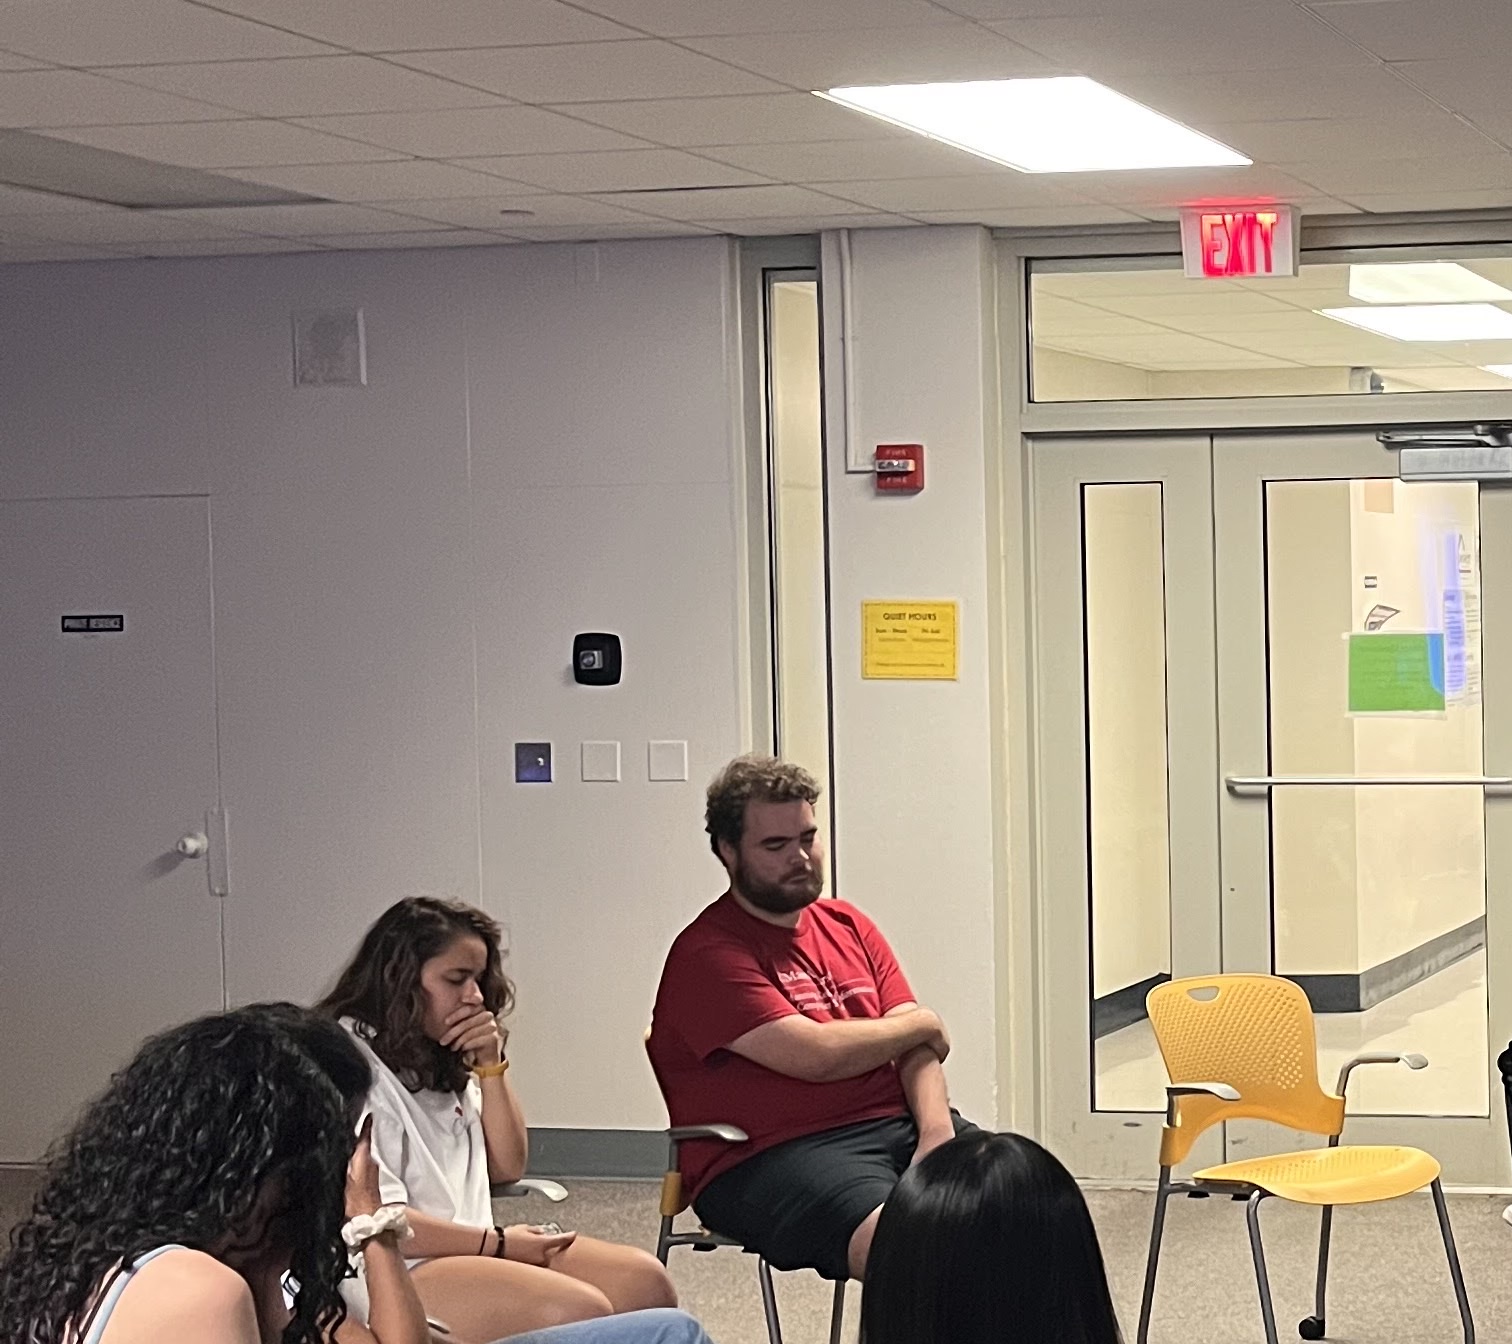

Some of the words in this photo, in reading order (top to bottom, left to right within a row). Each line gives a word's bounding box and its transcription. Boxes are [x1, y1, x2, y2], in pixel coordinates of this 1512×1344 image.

[1201, 211, 1278, 277] EXIT
[882, 612, 907, 621] QUIET
[908, 612, 938, 621] HOURS
